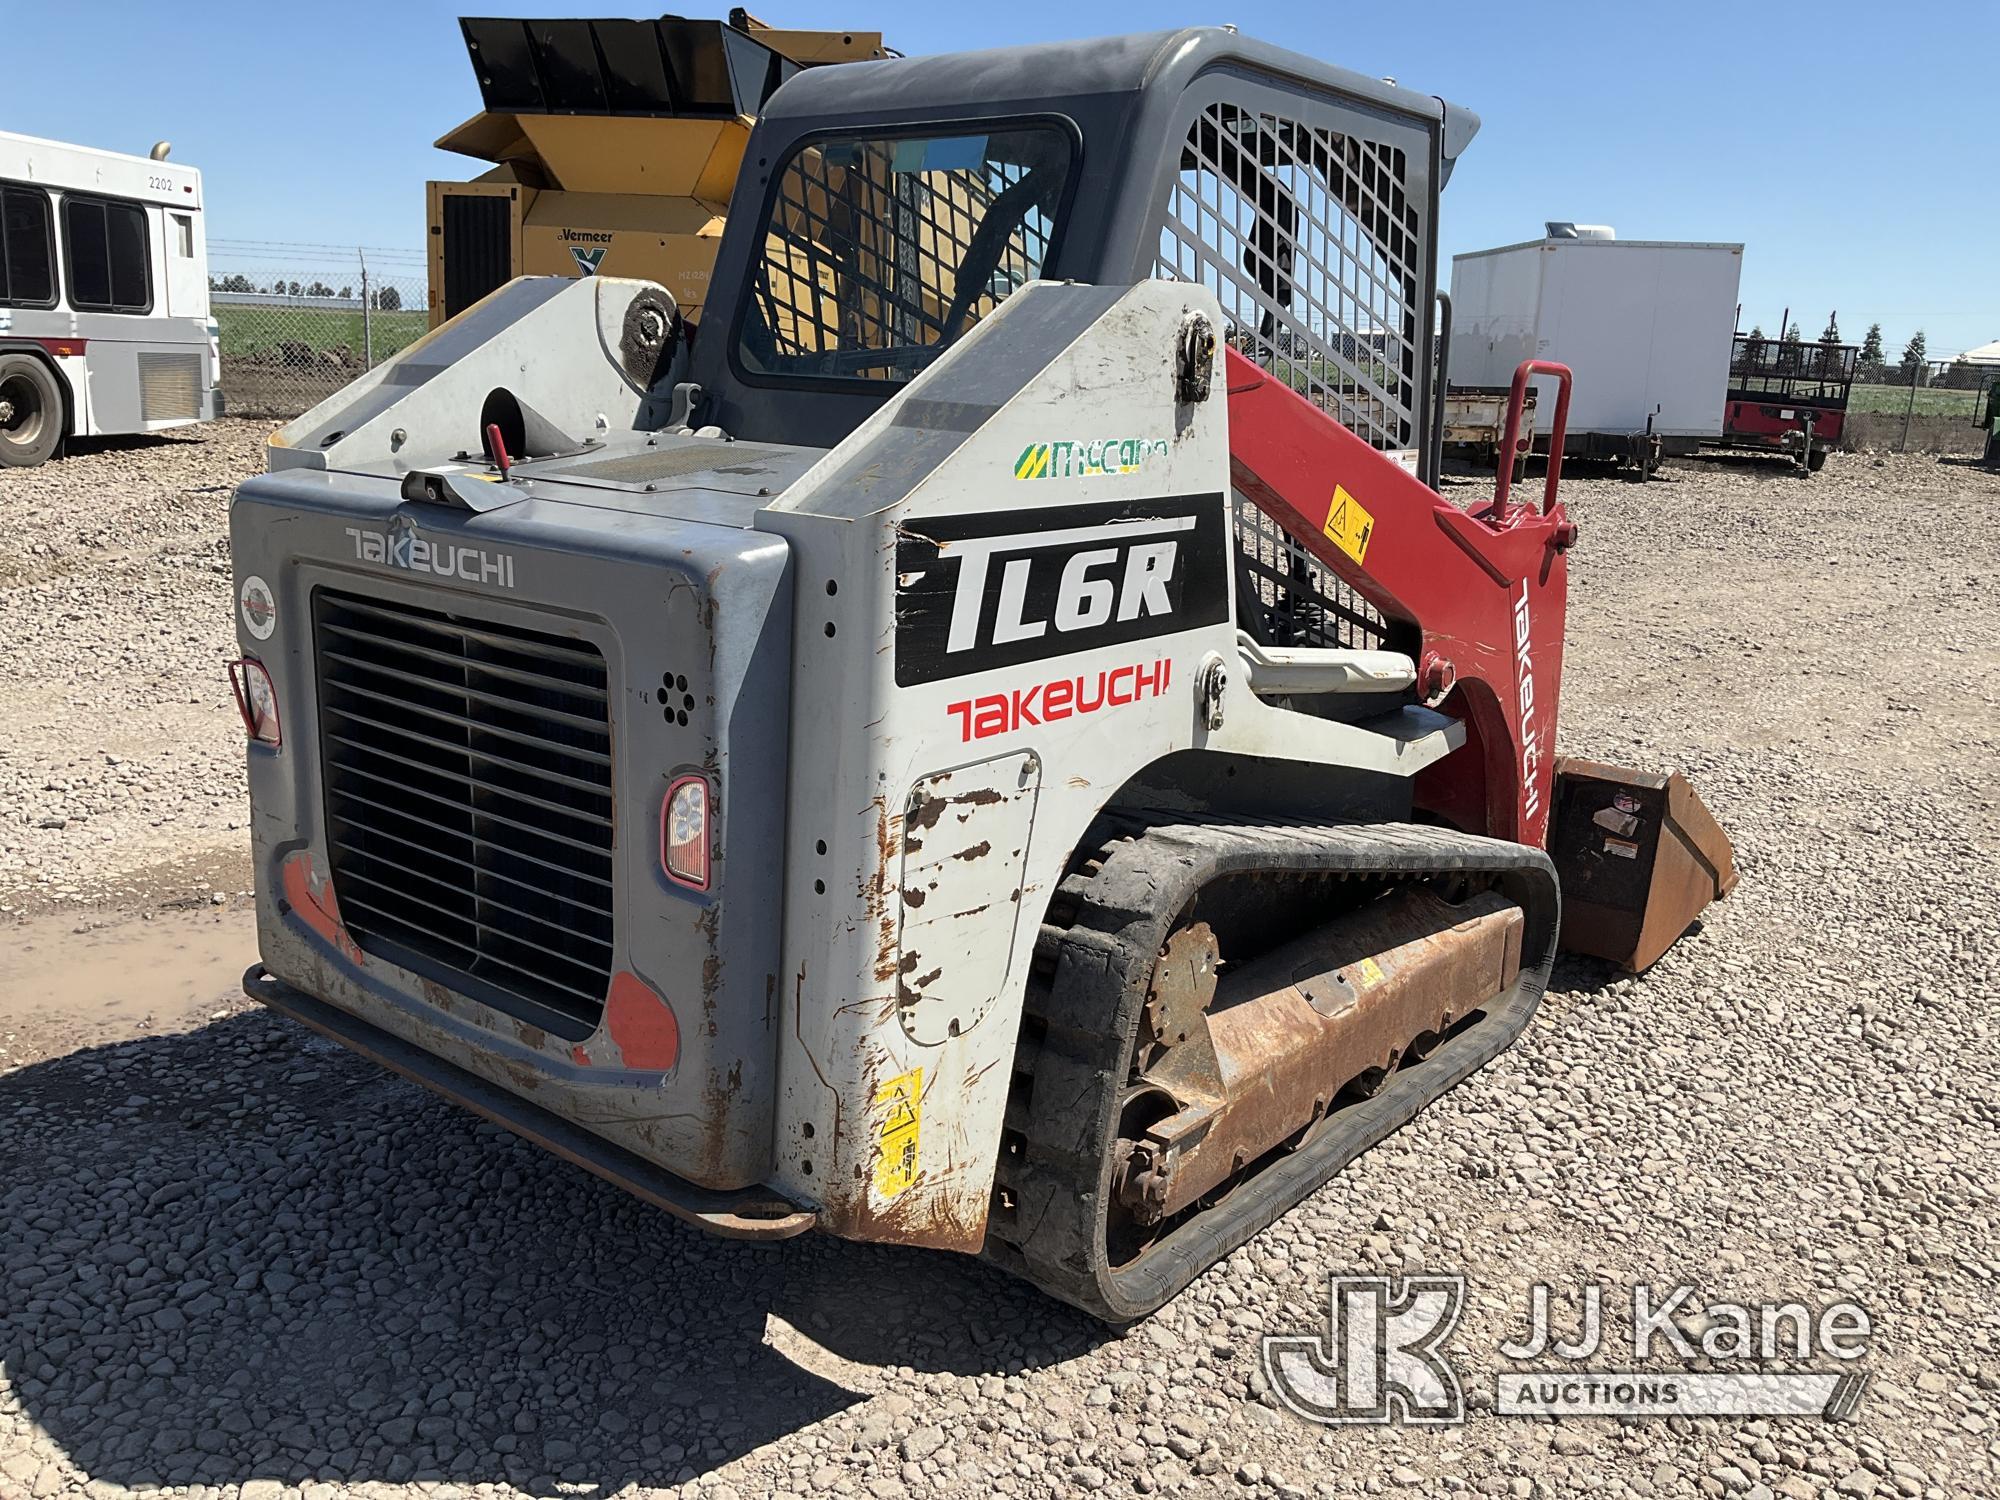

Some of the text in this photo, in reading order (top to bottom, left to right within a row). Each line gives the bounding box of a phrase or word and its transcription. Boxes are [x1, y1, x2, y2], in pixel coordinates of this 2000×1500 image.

[149, 176, 173, 191] 2202
[562, 229, 613, 243] Vermeer
[345, 527, 514, 588] TAKEUCHI
[938, 515, 1197, 653] TL6R
[947, 658, 1171, 742] TAKEUCHI
[1515, 577, 1539, 821] TAKEUCHI
